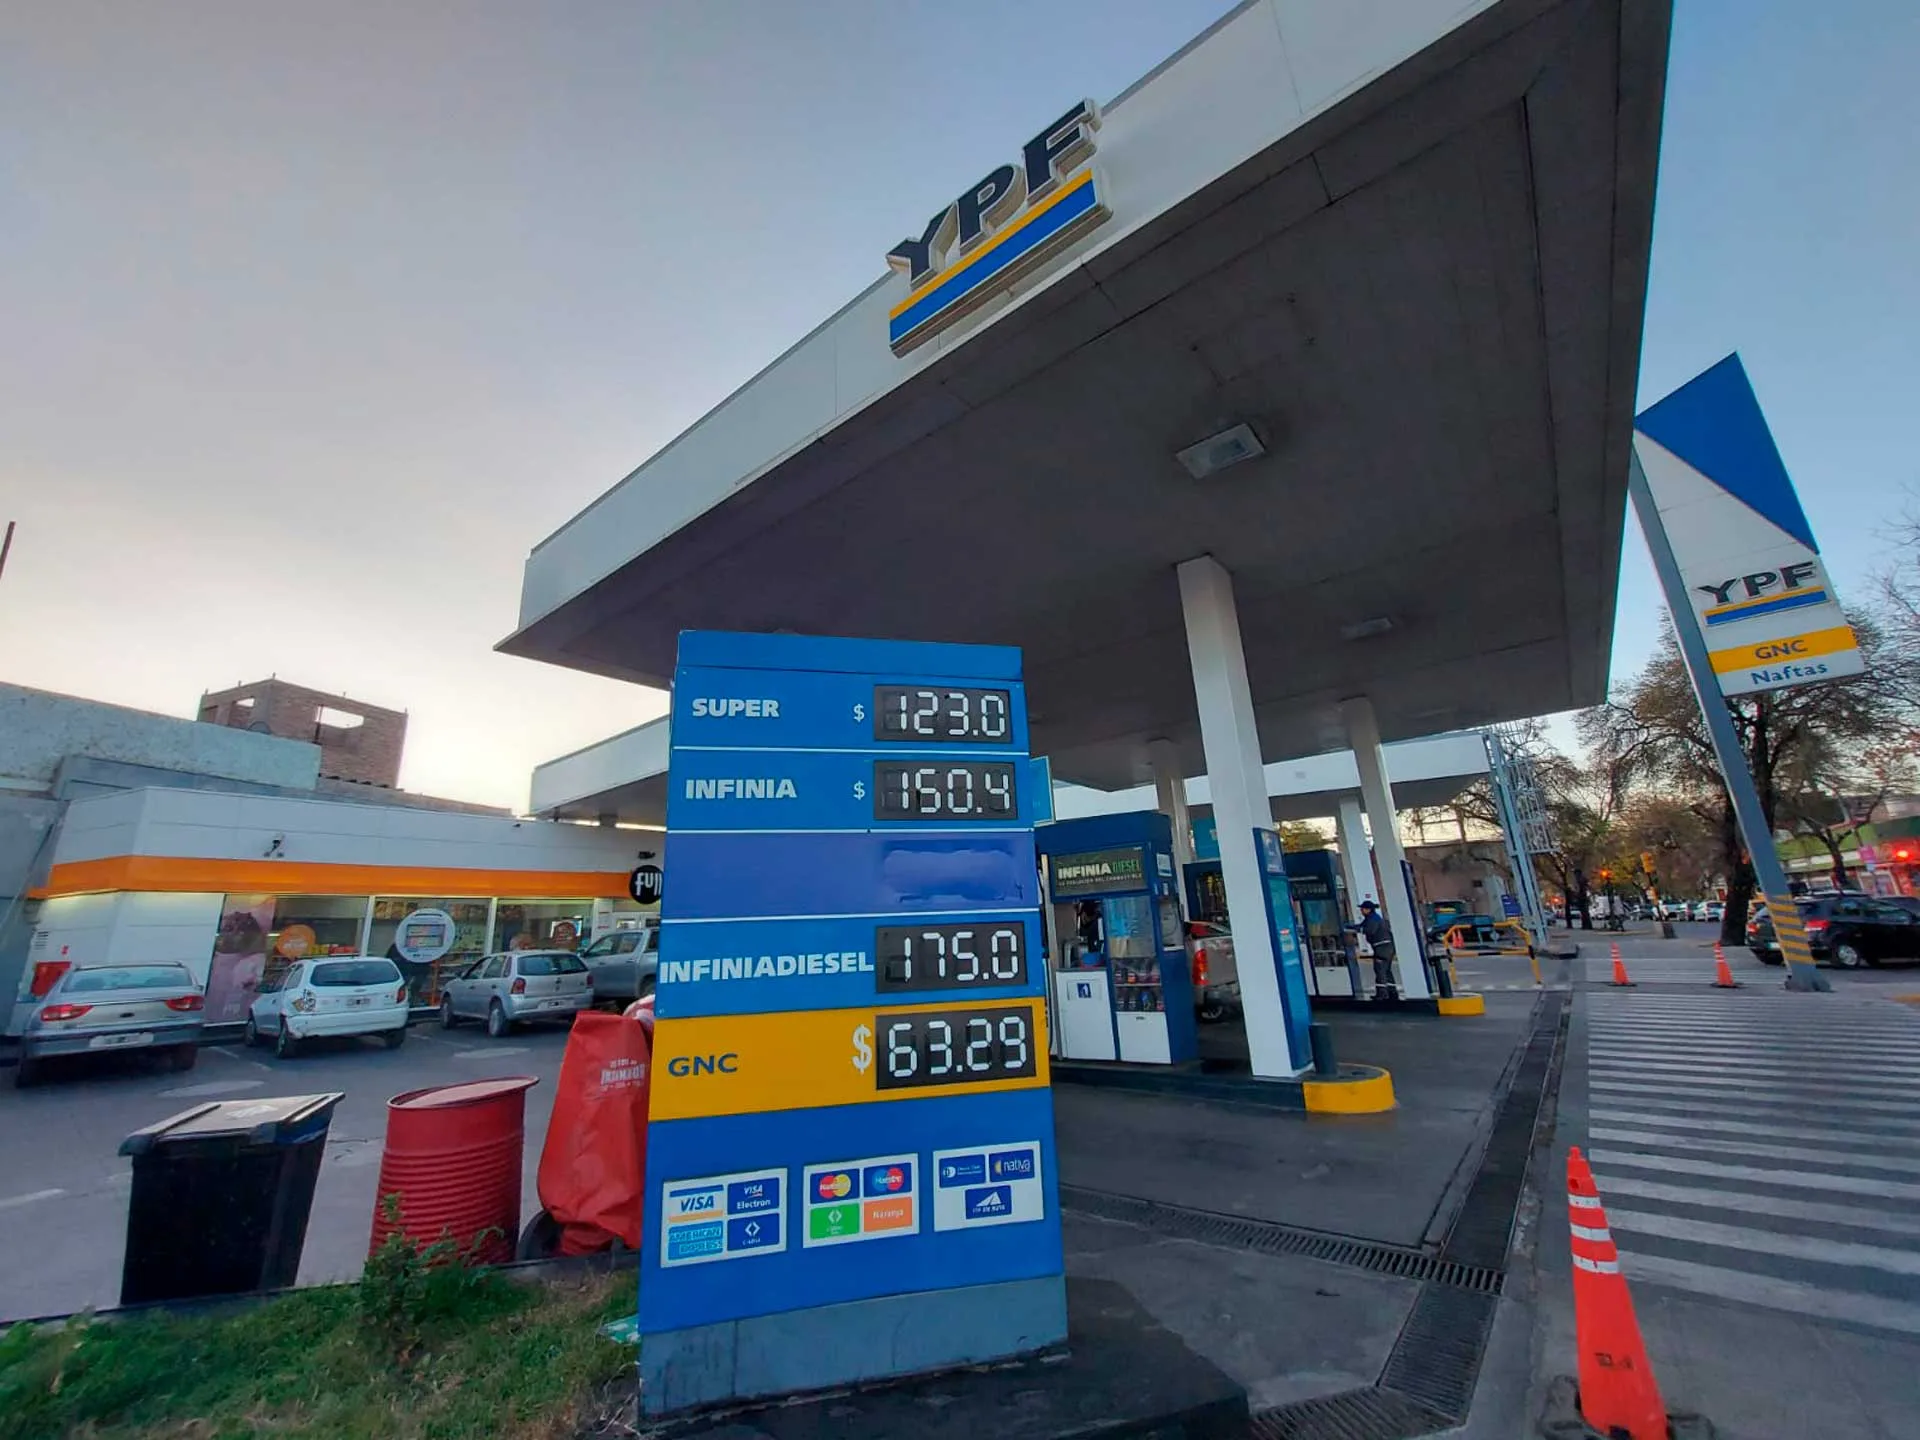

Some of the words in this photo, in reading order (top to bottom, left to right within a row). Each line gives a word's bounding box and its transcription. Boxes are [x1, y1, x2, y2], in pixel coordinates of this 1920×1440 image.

[886, 98, 1098, 288] YPF
[1697, 560, 1817, 607] YPF
[1754, 639, 1809, 660] GNC
[1751, 661, 1828, 685] Naftas
[691, 697, 780, 719] SUPER
[853, 703, 865, 723] $
[900, 691, 1006, 737] 123.0
[685, 778, 798, 800] INFINIA
[853, 780, 866, 801] $
[901, 768, 1010, 814] 150.4
[1057, 862, 1113, 881] INFINIA
[903, 929, 1018, 983] 175.0
[851, 1023, 873, 1076] $
[887, 1015, 1028, 1078] 63.29
[668, 1052, 739, 1078] GNC
[744, 1184, 763, 1197] VISA
[681, 1195, 715, 1212] VISA
[736, 1199, 771, 1210] Electron
